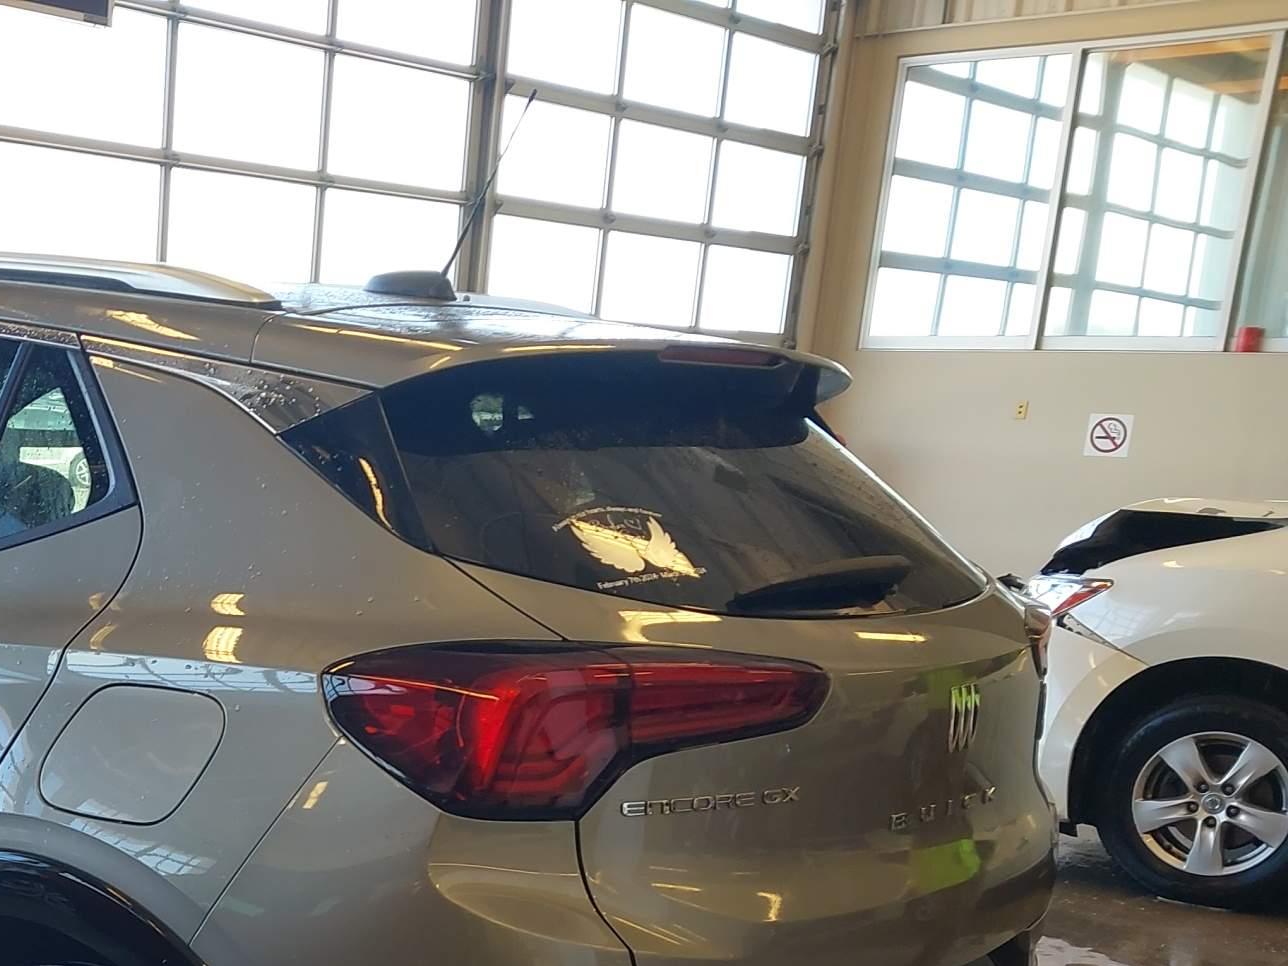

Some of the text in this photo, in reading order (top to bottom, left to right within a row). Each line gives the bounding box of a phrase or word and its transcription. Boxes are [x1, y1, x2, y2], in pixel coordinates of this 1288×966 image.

[620, 786, 801, 818] ENCORE GX
[889, 785, 997, 831] BUICK
